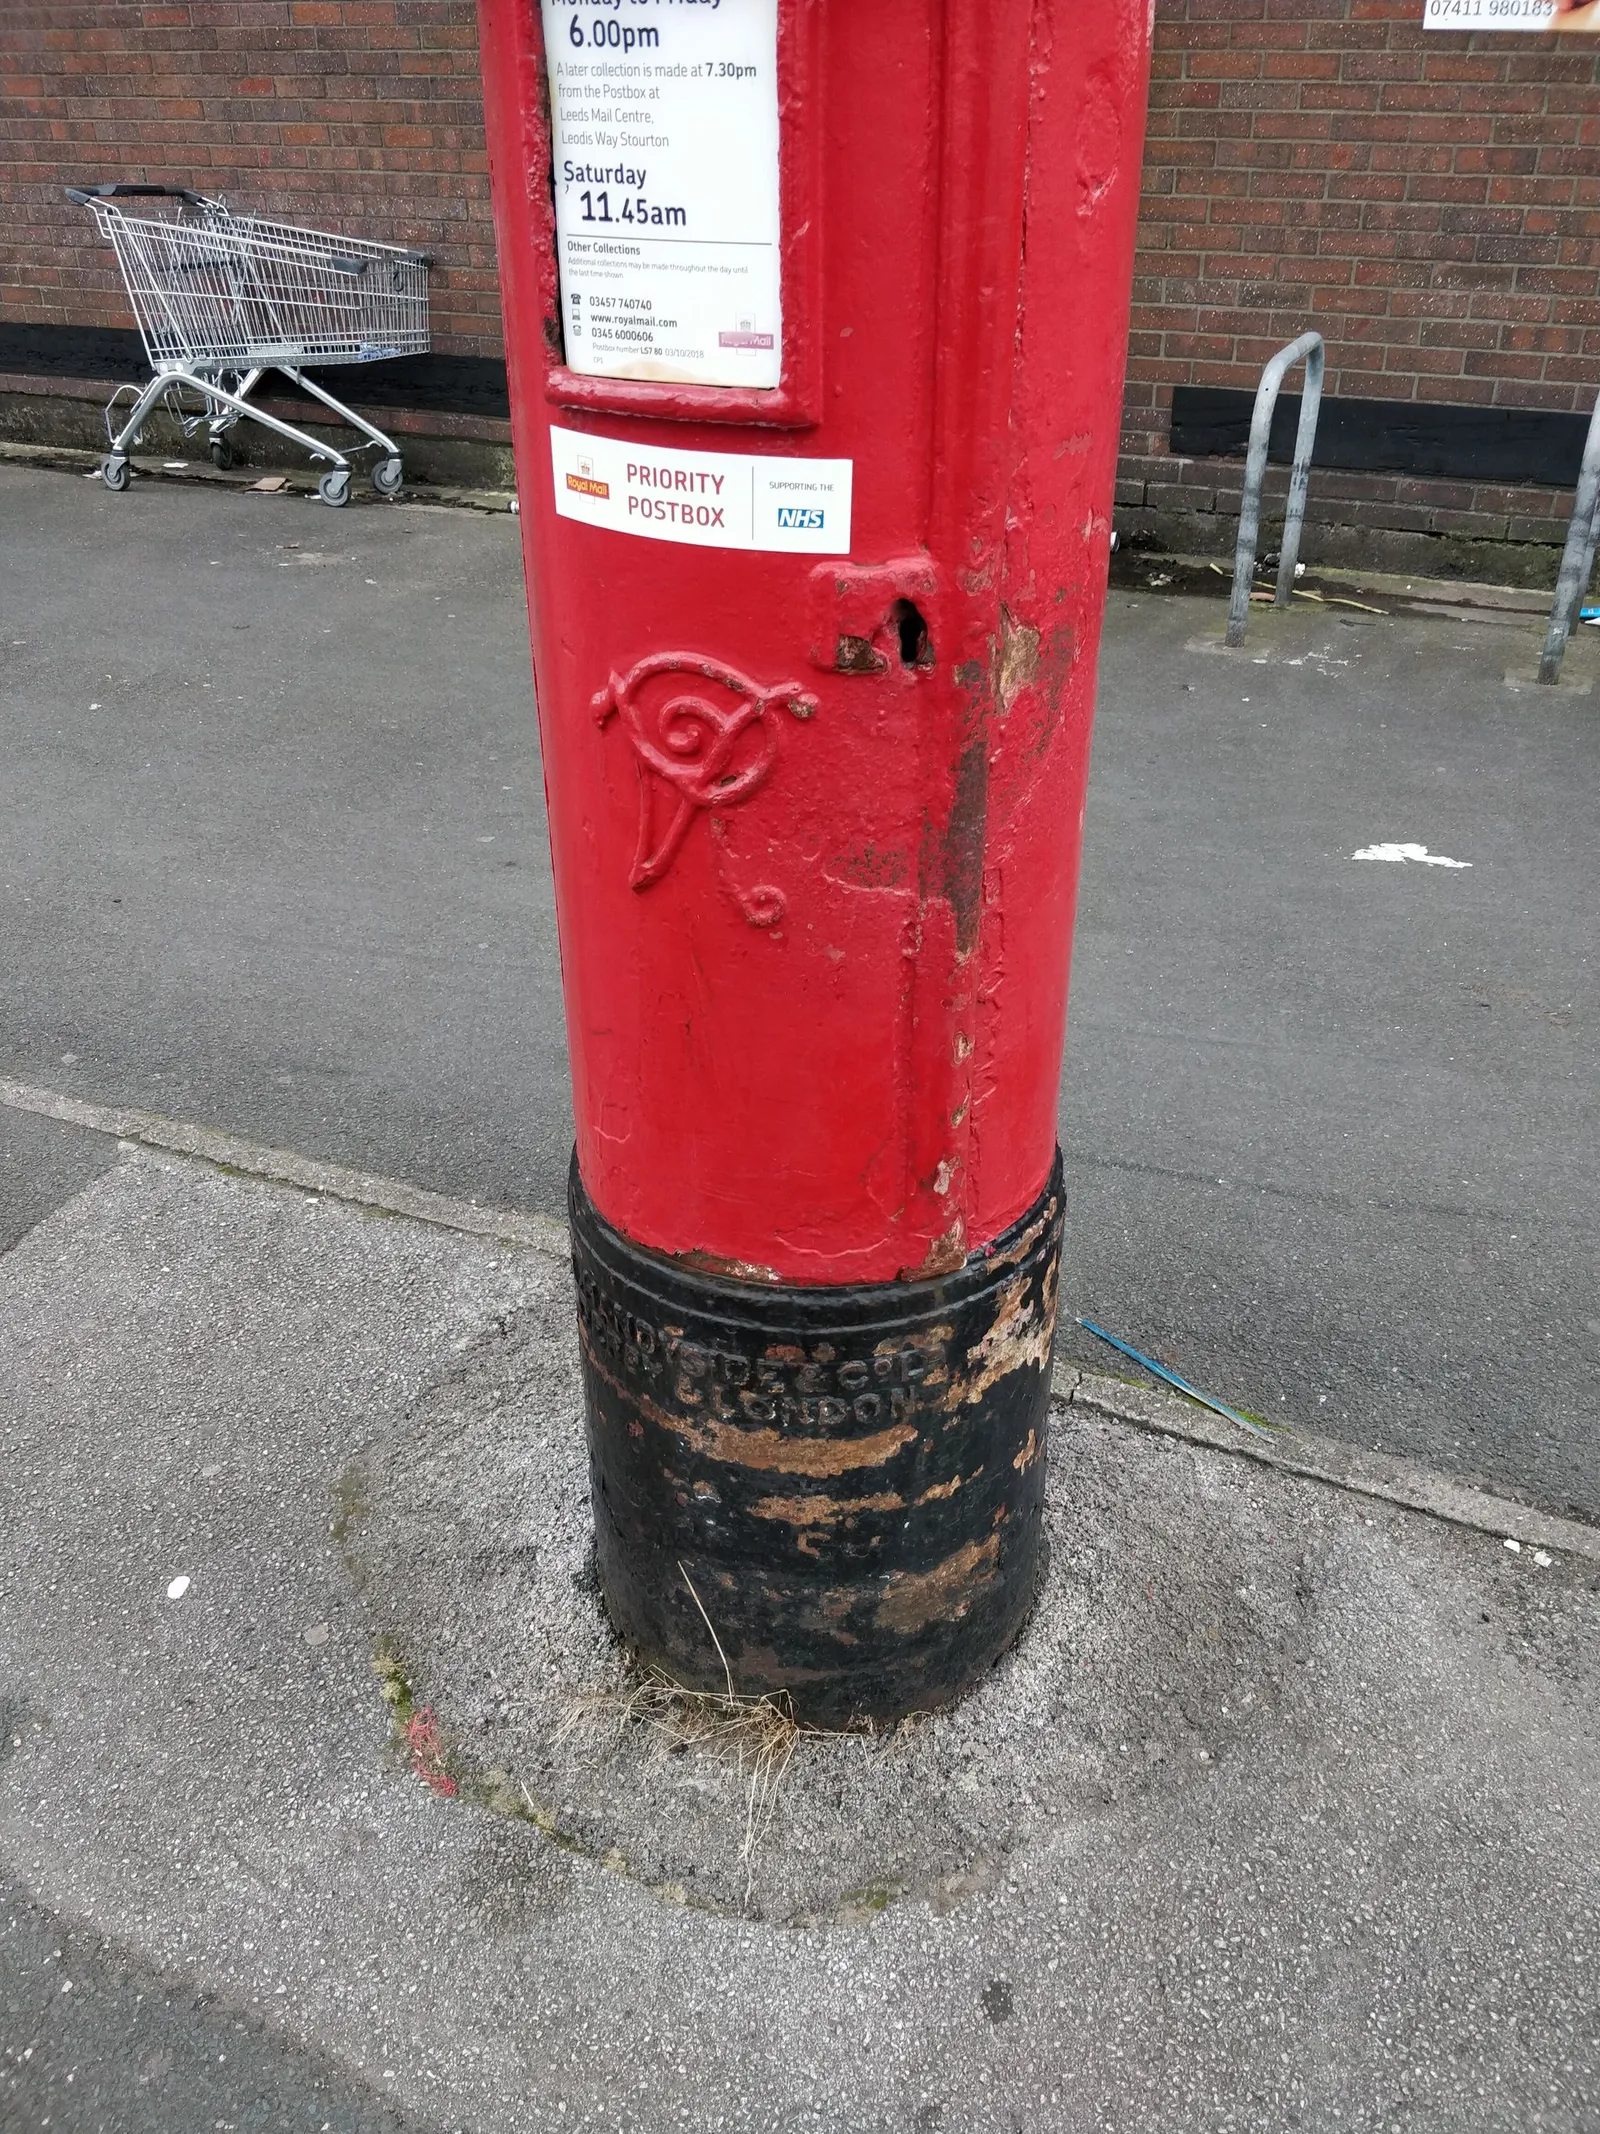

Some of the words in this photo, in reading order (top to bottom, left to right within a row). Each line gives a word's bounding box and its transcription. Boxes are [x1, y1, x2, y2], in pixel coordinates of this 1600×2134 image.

[1430, 0, 1482, 16] 07411
[569, 14, 660, 53] 6.00pm
[557, 63, 564, 76] A
[565, 63, 588, 77] later
[591, 63, 641, 77] collection
[643, 63, 652, 77] is
[655, 63, 688, 77] made
[691, 64, 704, 77] at
[705, 63, 757, 79] 7.30pm
[558, 84, 582, 98] from
[584, 84, 601, 98] the
[603, 85, 646, 99] Postbox
[649, 86, 660, 99] at
[560, 108, 589, 122] Leeds
[591, 108, 612, 123] Mail
[615, 109, 654, 124] Centre,
[561, 131, 593, 146] Leodis
[595, 132, 618, 148] Way
[620, 134, 670, 147] Stourton
[564, 161, 646, 189] Saturday
[580, 191, 687, 226] 11.45am
[567, 241, 591, 253] Other
[593, 243, 641, 255] Collections
[628, 262, 642, 270] may
[670, 264, 706, 273] throughout
[719, 266, 732, 274] day
[589, 296, 616, 308] 03457
[618, 298, 652, 310] 740740
[590, 313, 678, 328] www.royalmail.com
[592, 328, 613, 338] 0345
[615, 329, 654, 342] 6000606
[592, 342, 615, 352] Postbox
[640, 346, 653, 354] LS7
[664, 349, 704, 359] 03/10/2018
[566, 475, 589, 492] Royal
[589, 481, 609, 496] Mail
[626, 463, 726, 496] PRIORITY
[768, 481, 818, 492] SUPPORTING
[819, 483, 835, 492] THE
[627, 496, 726, 528] POSTBOX
[779, 510, 823, 528] NHS
